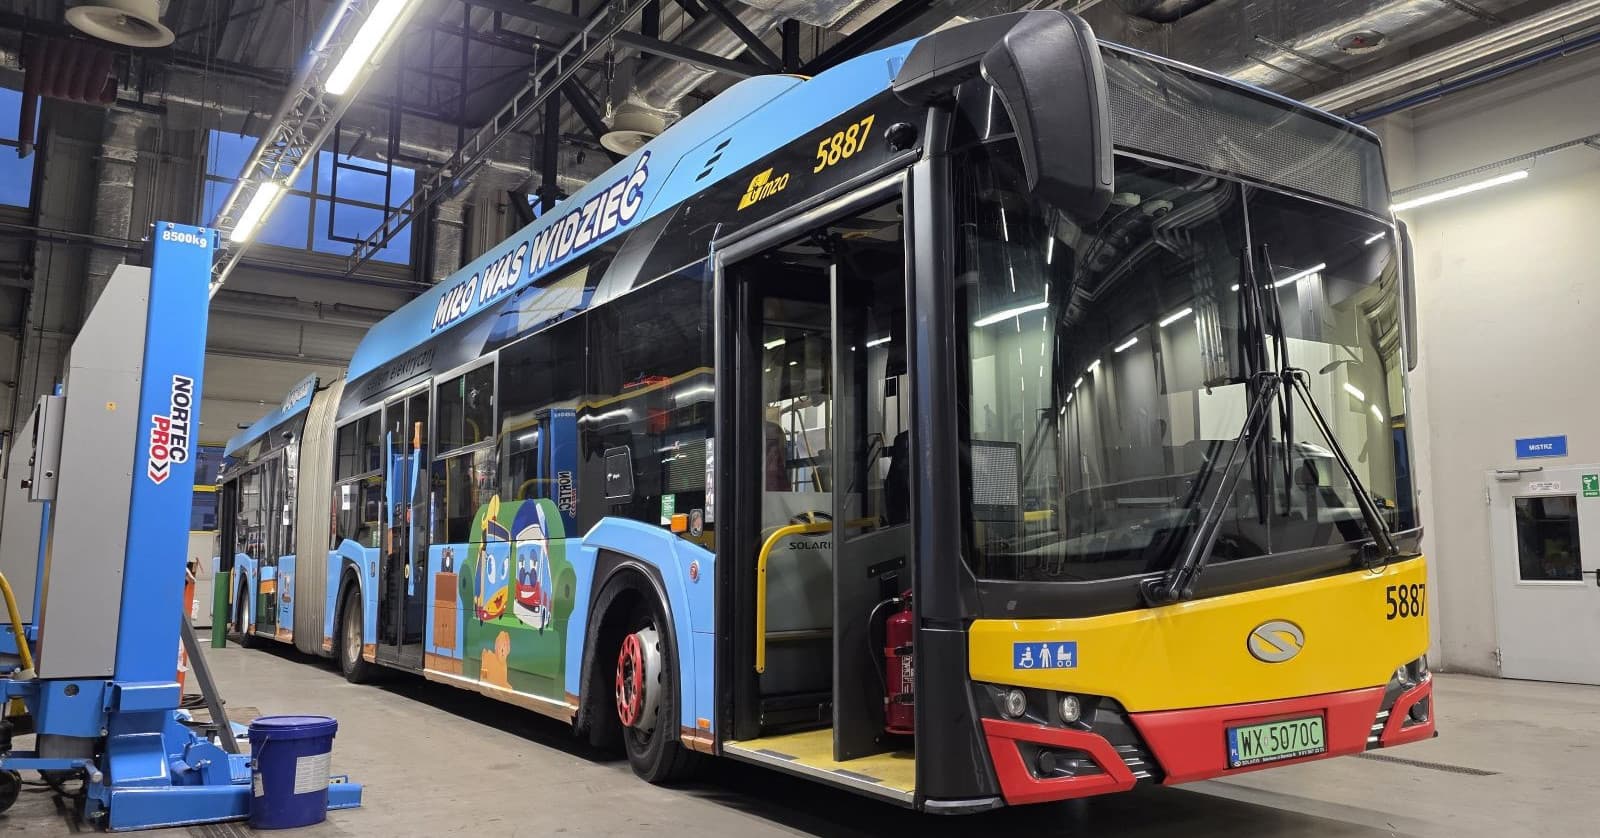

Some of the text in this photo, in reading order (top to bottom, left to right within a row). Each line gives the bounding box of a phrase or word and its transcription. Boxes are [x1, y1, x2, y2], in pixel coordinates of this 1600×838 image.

[813, 113, 875, 174] 5887
[162, 230, 208, 249] 8500kg
[430, 150, 651, 333] MIŁO WAS WIDZIEĆ
[151, 415, 171, 461] PRO
[168, 375, 193, 463] NORTEC
[1386, 583, 1426, 621] 5887
[1231, 748, 1238, 757] PL
[1241, 728, 1265, 758] WX
[1270, 721, 1320, 752] 5070C
